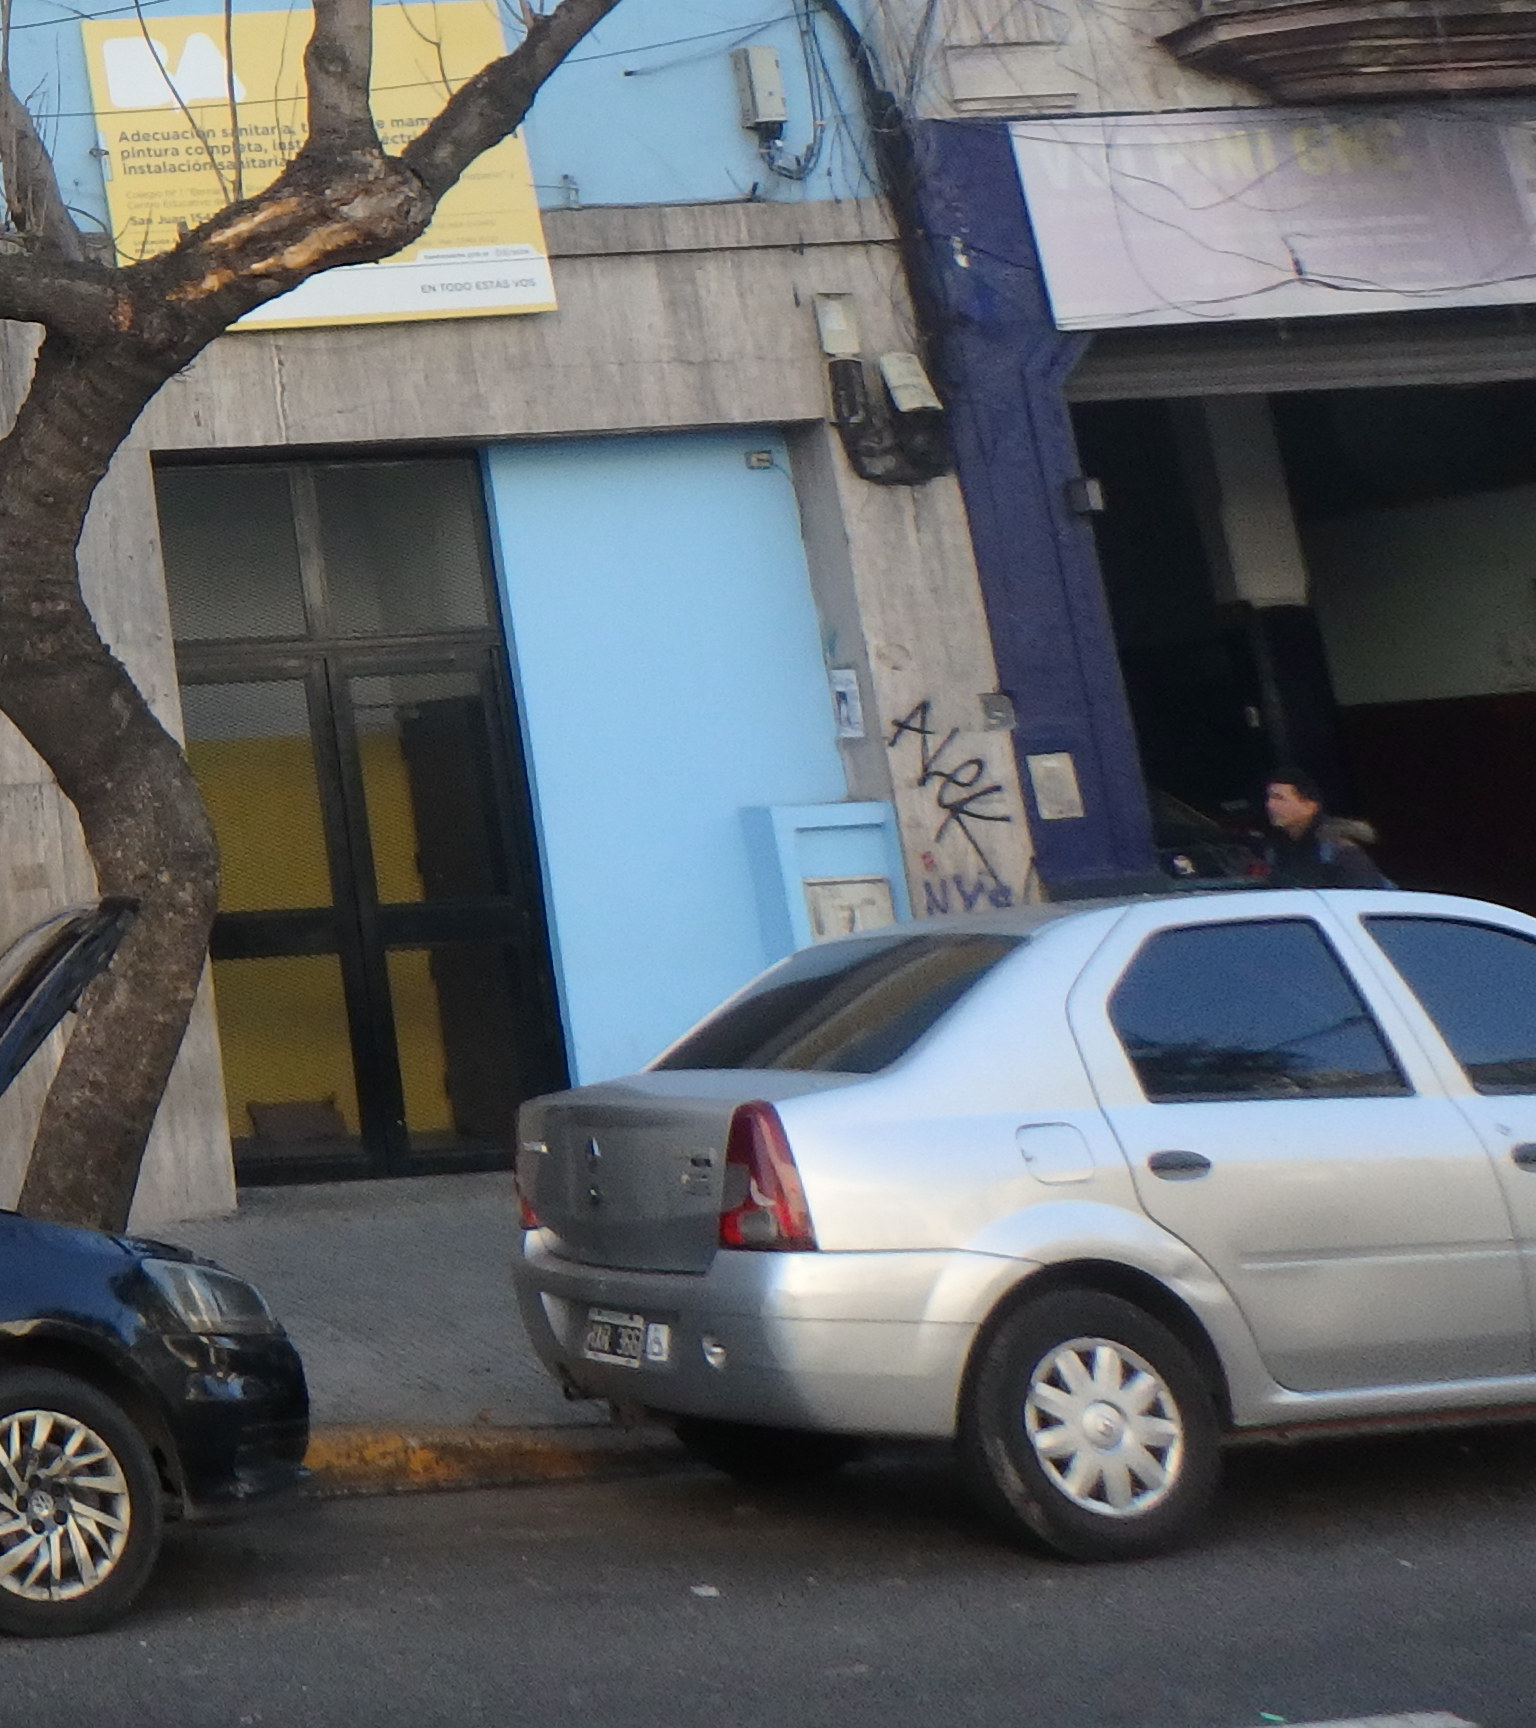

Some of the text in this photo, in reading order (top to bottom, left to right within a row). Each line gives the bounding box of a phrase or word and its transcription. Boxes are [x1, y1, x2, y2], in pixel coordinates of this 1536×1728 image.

[119, 128, 216, 143] Adecuacin
[120, 146, 180, 161] pintura
[185, 141, 268, 156] competa,
[440, 281, 472, 292] TODO
